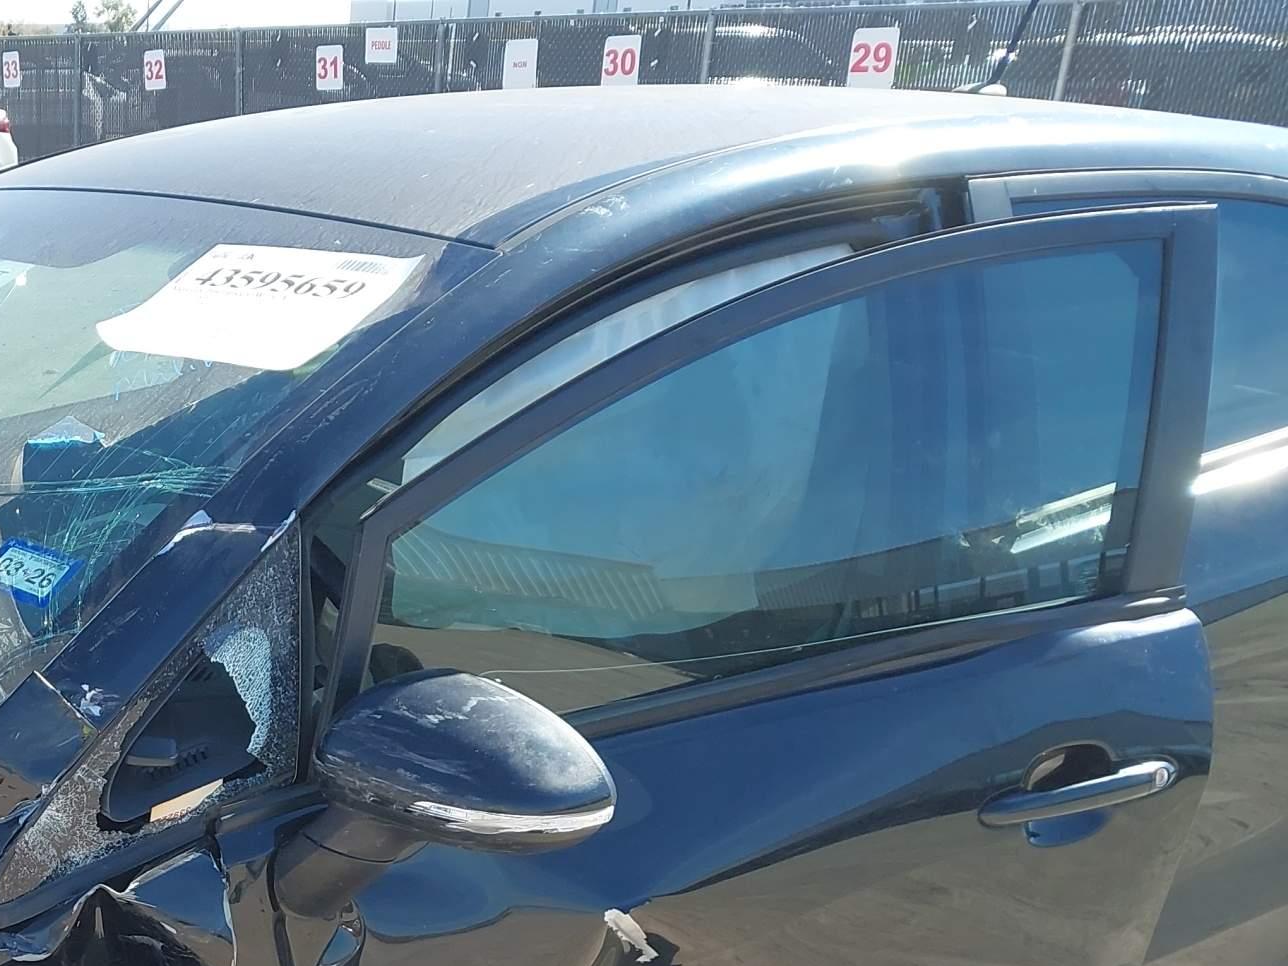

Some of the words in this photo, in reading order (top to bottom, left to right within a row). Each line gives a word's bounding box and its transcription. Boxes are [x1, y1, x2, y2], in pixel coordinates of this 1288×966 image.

[371, 40, 392, 50] PEDDLE
[4, 60, 19, 80] 33
[145, 59, 164, 81] 32
[317, 56, 340, 80] 31
[603, 47, 638, 78] 30
[850, 42, 894, 77] 29
[195, 267, 366, 300] 43595659
